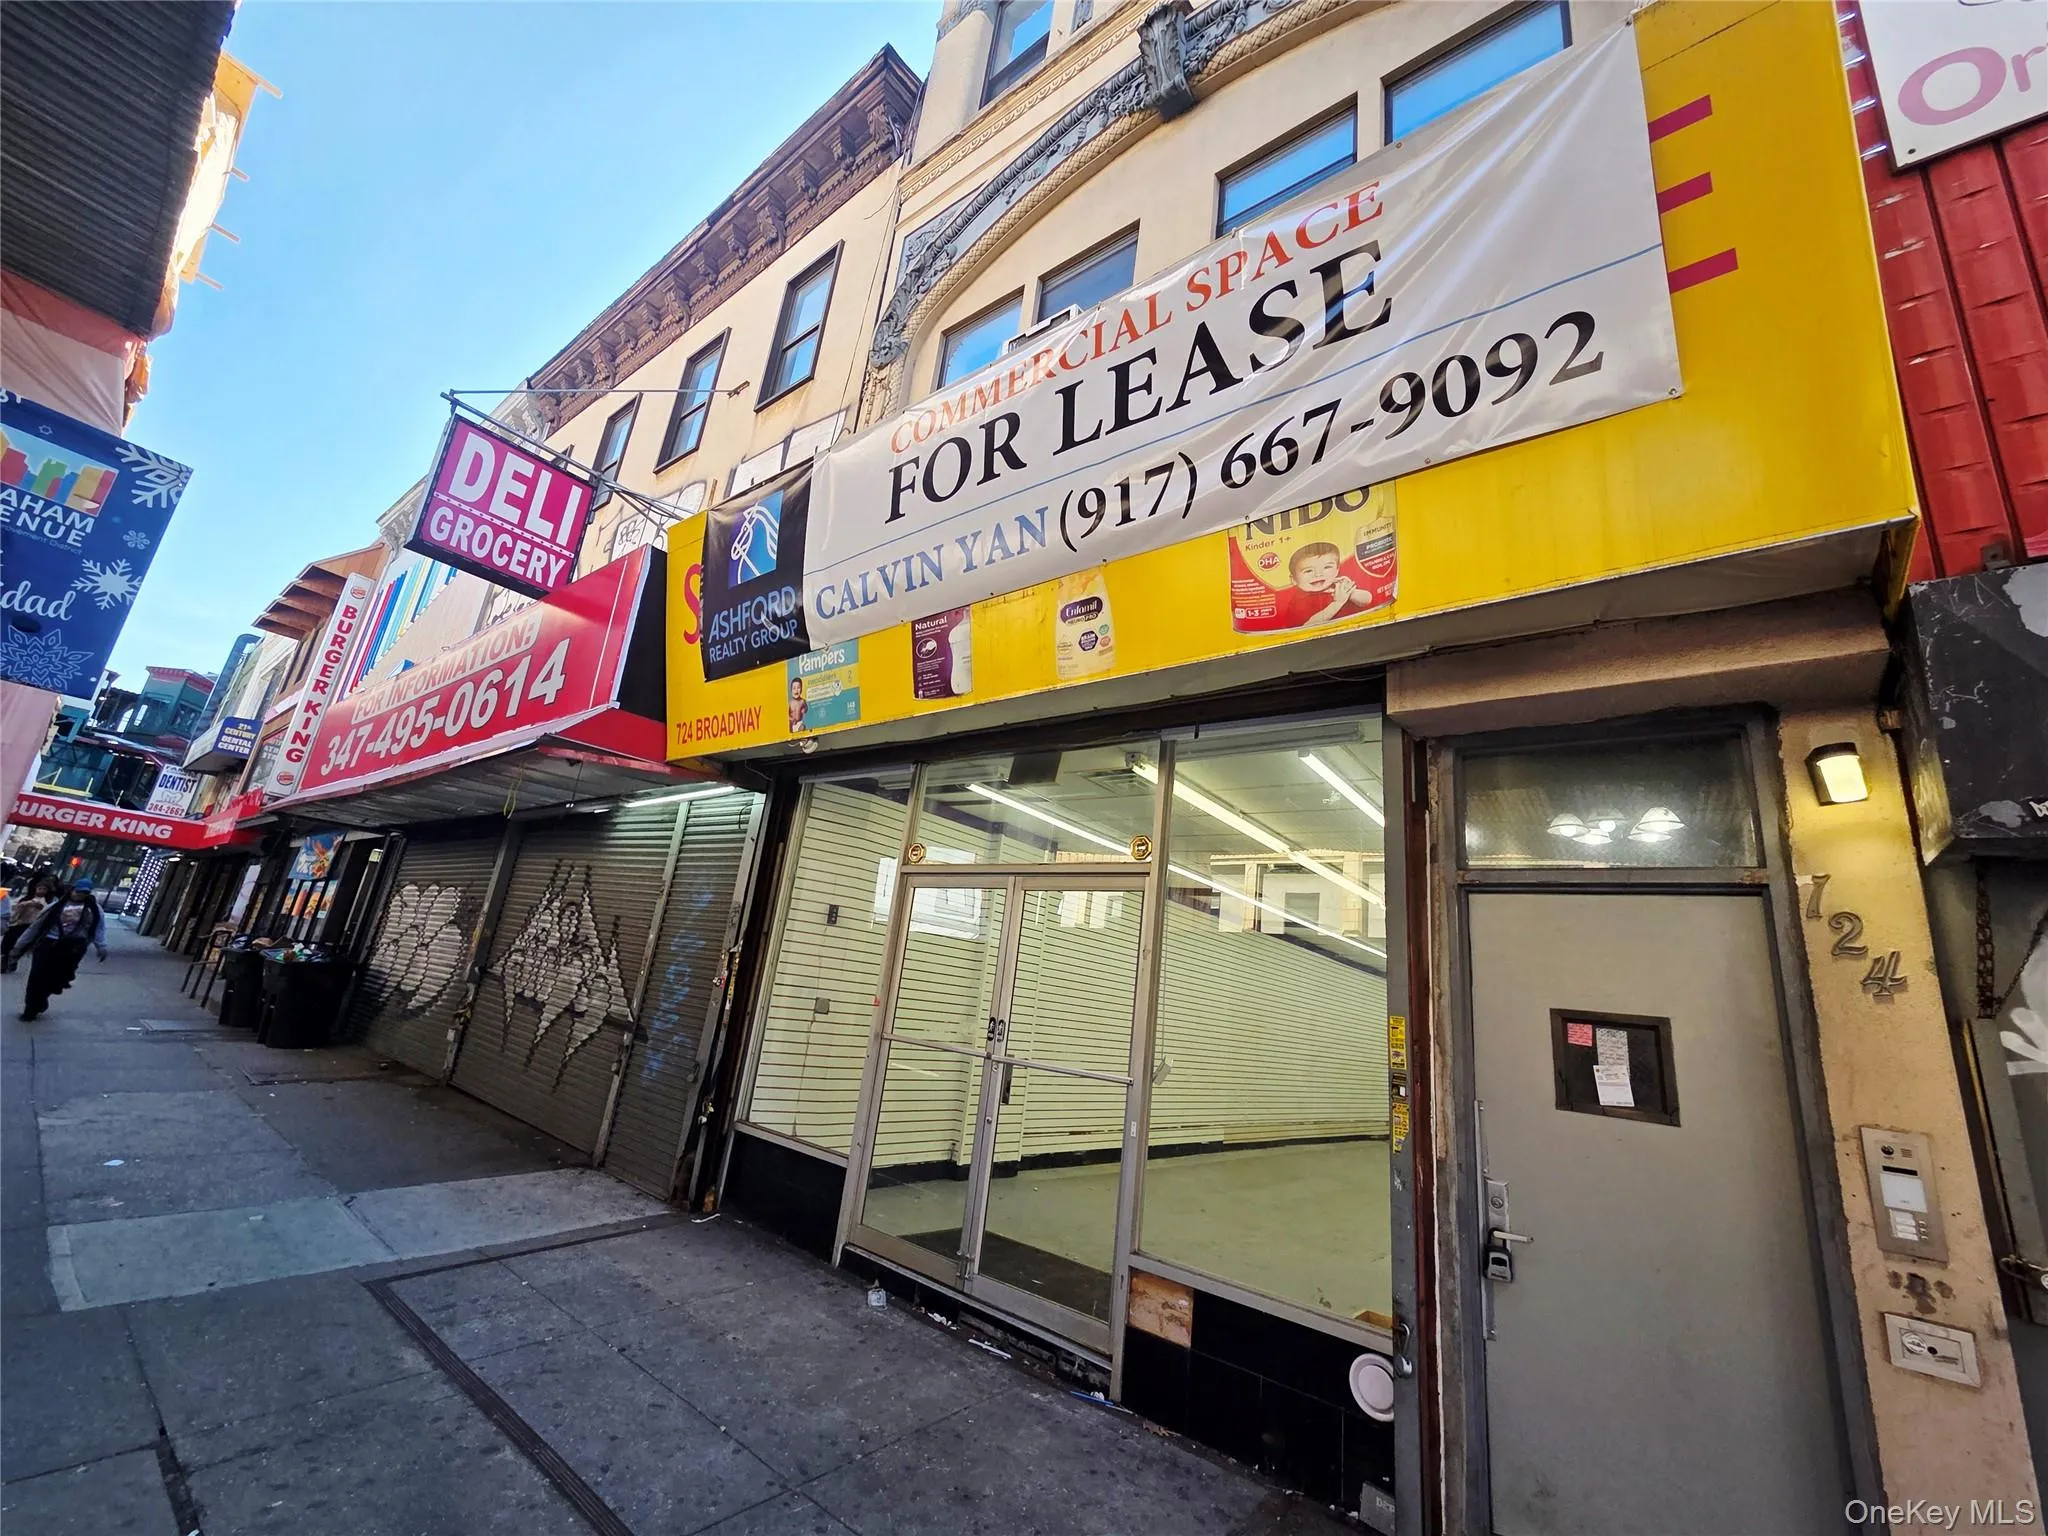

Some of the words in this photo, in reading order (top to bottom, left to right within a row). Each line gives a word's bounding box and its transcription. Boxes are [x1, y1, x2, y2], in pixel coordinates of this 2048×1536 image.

[889, 290, 1173, 455] COMMERCIAL
[1185, 180, 1384, 313] SPACE
[884, 411, 1027, 524] FOR
[1052, 240, 1393, 457] LEASE
[448, 431, 583, 547] DELI
[816, 543, 944, 620] CALVIN
[954, 505, 1049, 574] YAN
[1059, 450, 1198, 553] (917)
[1219, 311, 1605, 489] 667-9092
[430, 507, 567, 589] GROCERY
[1245, 539, 1274, 552] Kinder
[708, 586, 796, 643] ASHFORD
[915, 616, 947, 631] Natural
[311, 605, 358, 696] BURGER
[709, 636, 747, 664] REALTY
[751, 619, 798, 648] GROUP
[799, 648, 845, 674] Pampers
[357, 694, 387, 718] FOR
[386, 622, 534, 701] INFORMATION:
[286, 700, 322, 763] KING
[320, 638, 570, 776] 347-495-0614
[676, 721, 693, 744] 724
[696, 705, 762, 740] BROADWAY
[217, 742, 250, 755] CENTER
[221, 735, 252, 748] DENTAL
[224, 727, 256, 739] CENTURY
[158, 773, 197, 793] DENTIST
[110, 816, 173, 839] KING
